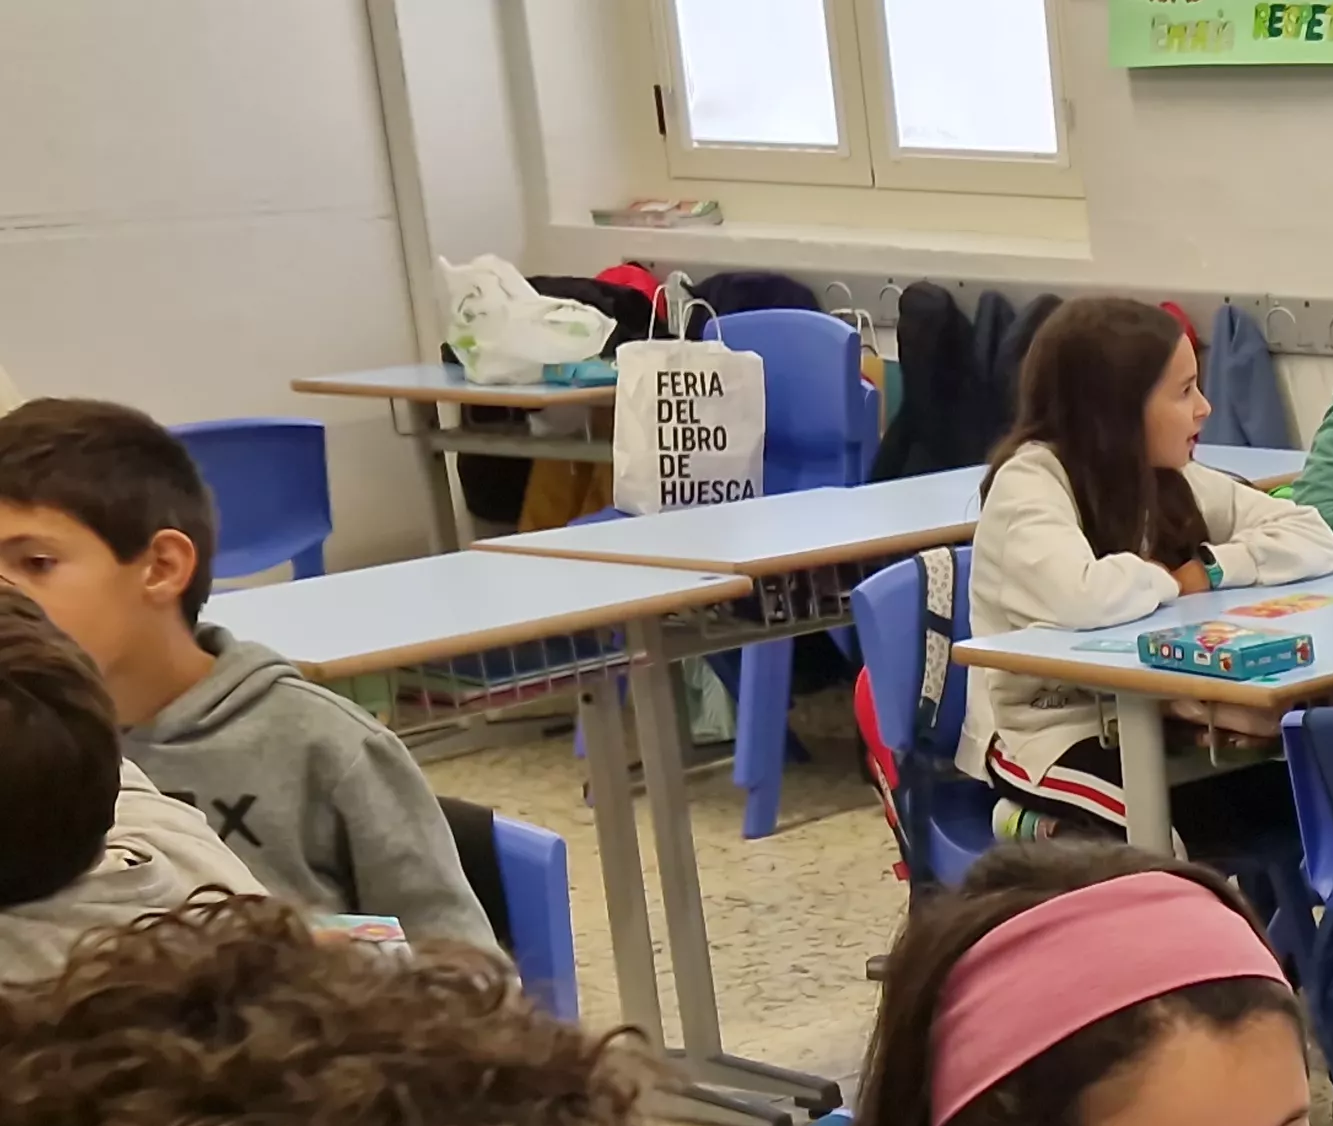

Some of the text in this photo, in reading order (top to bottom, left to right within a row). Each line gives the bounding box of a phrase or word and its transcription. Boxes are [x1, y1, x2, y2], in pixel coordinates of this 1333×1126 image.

[656, 370, 724, 398] FERIA
[657, 398, 701, 425] DEL
[657, 425, 728, 452] LIBRO
[659, 453, 692, 480] DE
[660, 479, 756, 506] HUESCA
